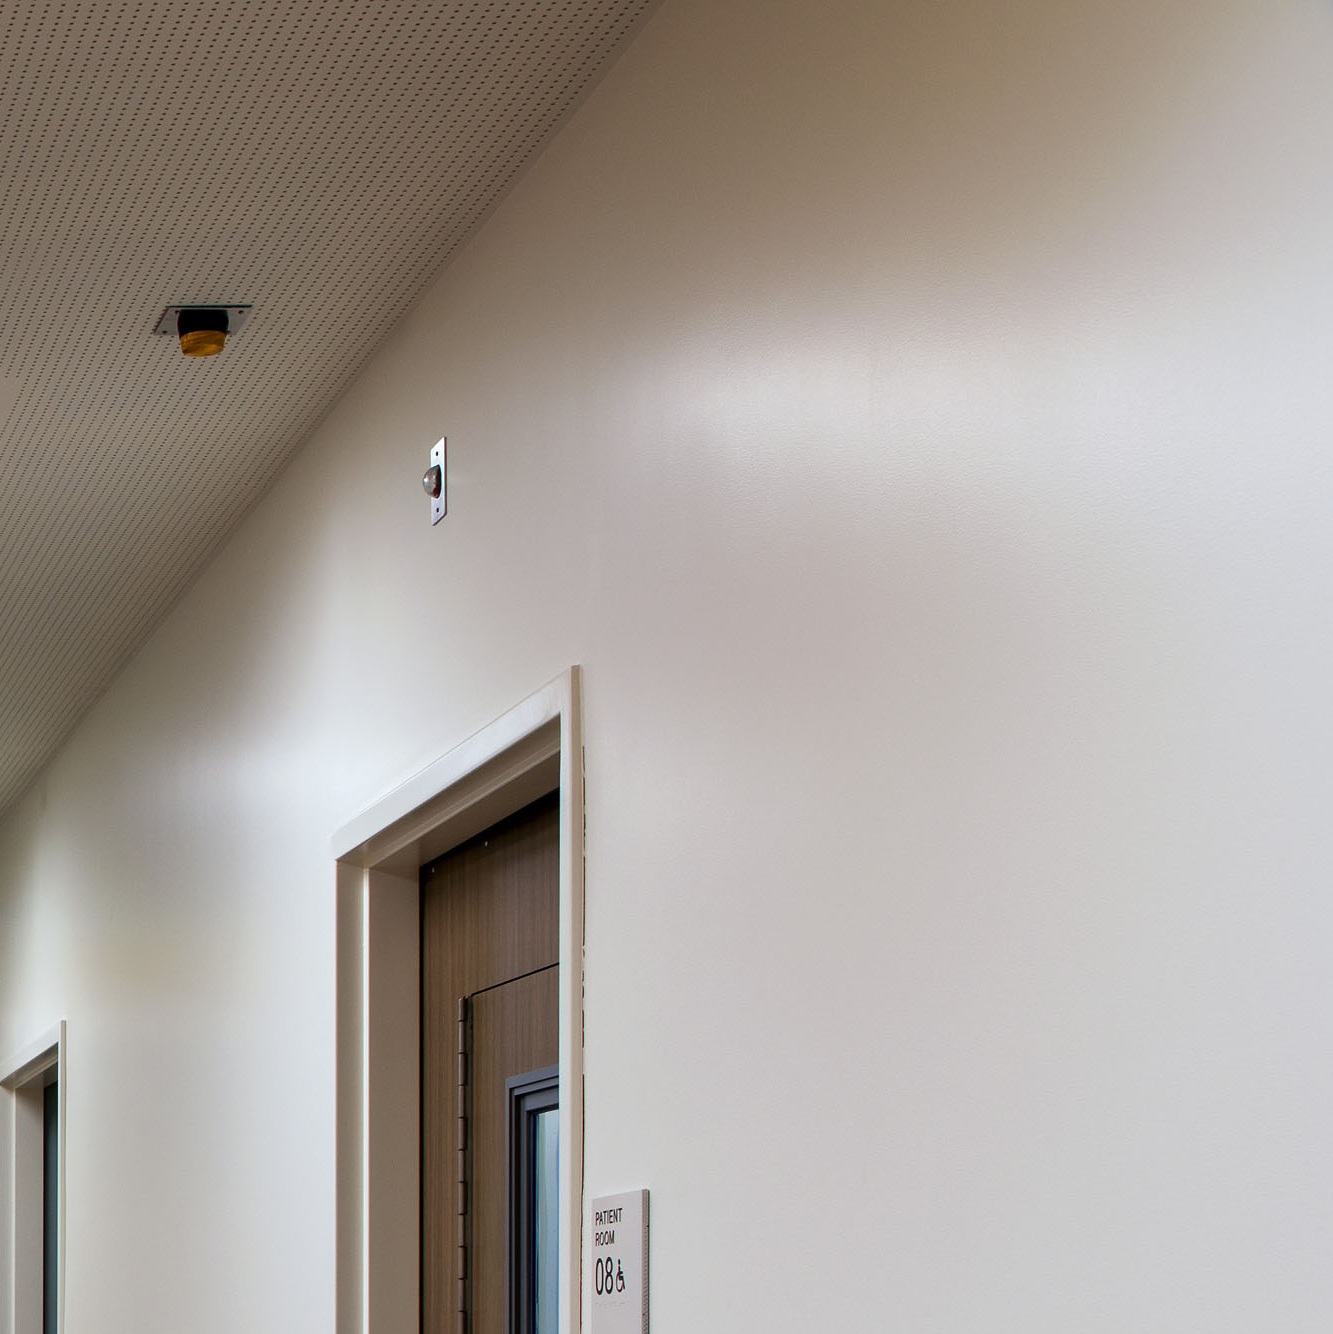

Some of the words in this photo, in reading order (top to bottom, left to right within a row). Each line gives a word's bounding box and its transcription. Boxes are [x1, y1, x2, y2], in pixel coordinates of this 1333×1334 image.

[595, 1207, 623, 1226] PATIENT
[595, 1230, 615, 1247] ROOM
[595, 1256, 614, 1296] 08
